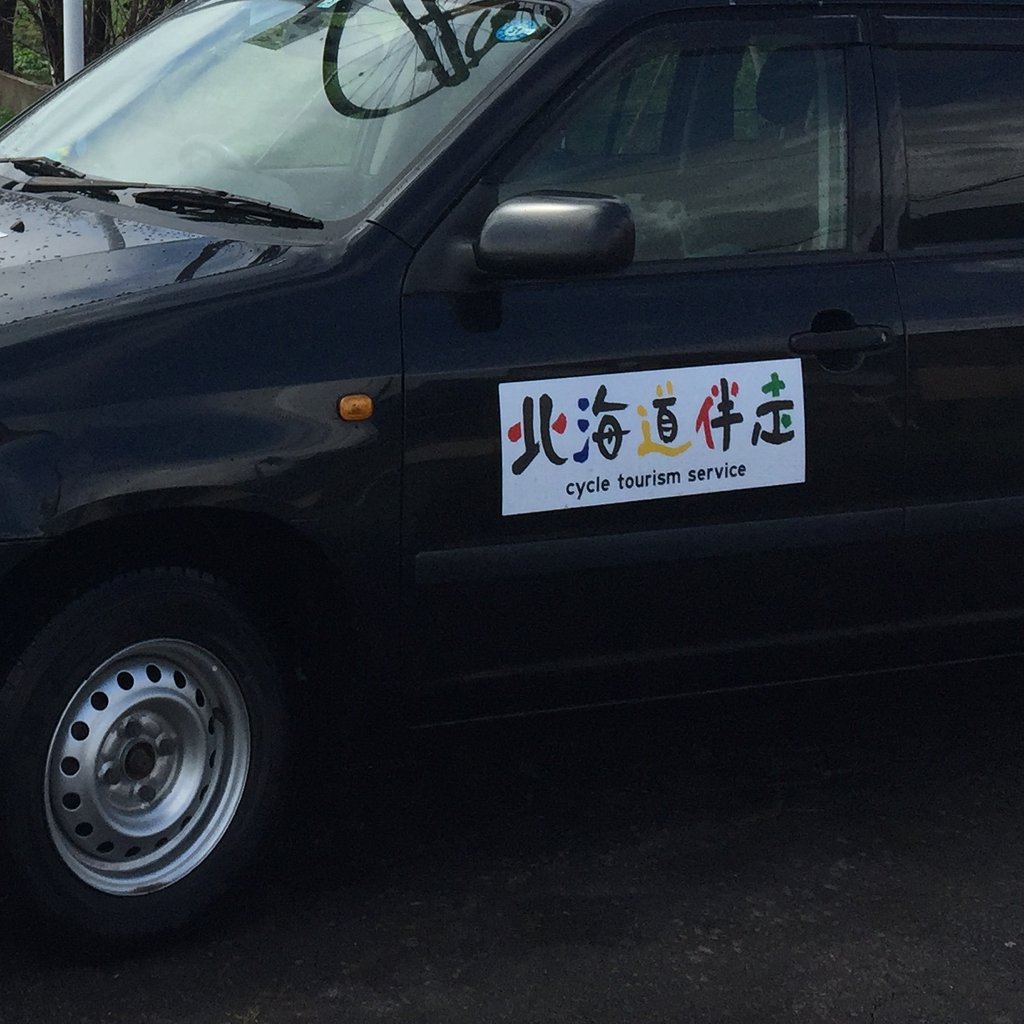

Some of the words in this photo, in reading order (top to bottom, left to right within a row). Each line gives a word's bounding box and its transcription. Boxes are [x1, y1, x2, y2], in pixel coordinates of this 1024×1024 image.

[566, 476, 610, 500] cycle
[618, 470, 681, 489] tourism
[688, 462, 747, 482] service
